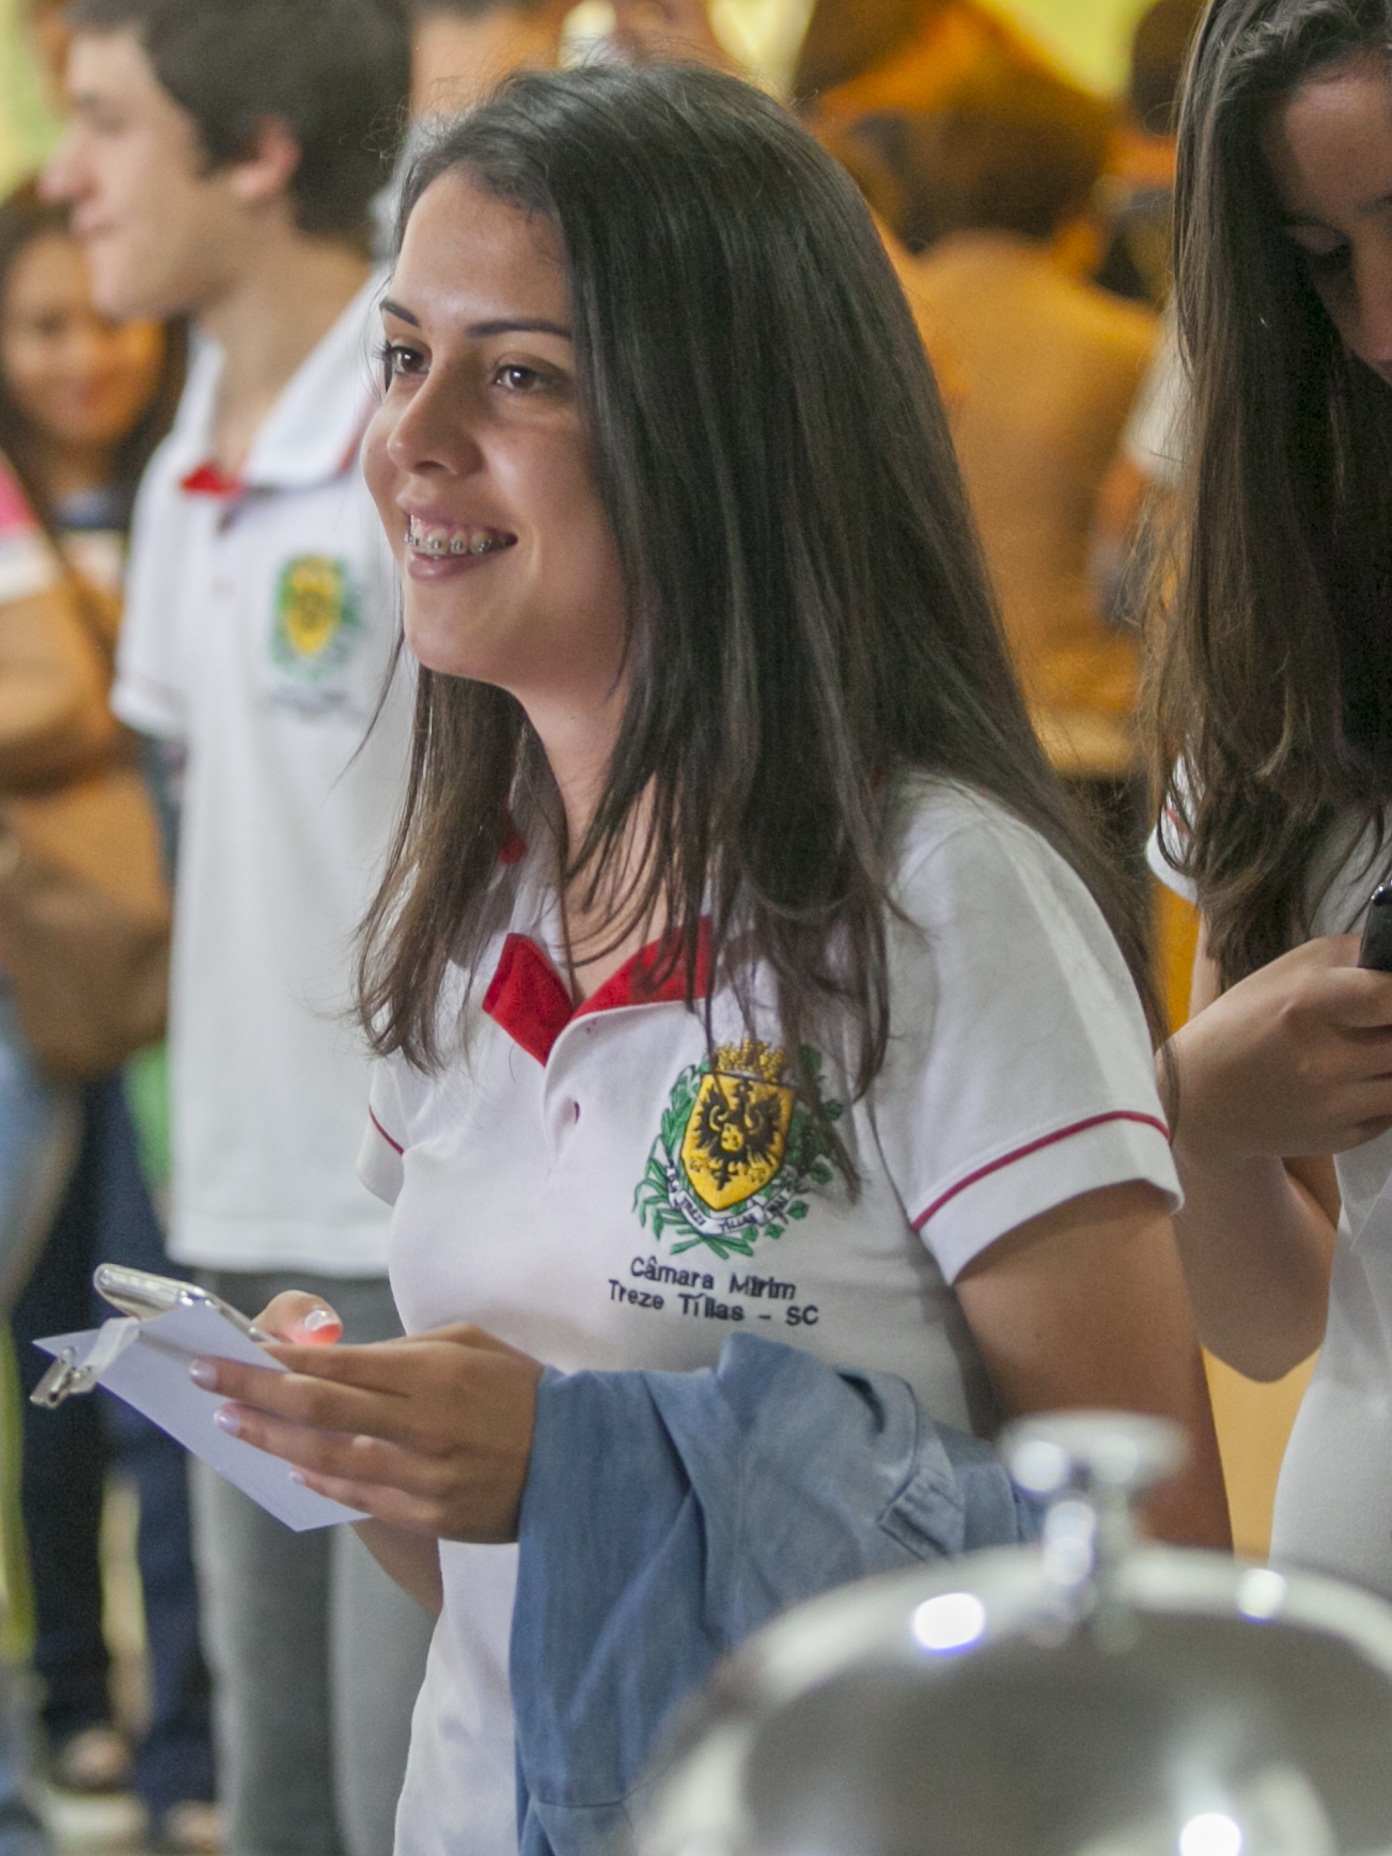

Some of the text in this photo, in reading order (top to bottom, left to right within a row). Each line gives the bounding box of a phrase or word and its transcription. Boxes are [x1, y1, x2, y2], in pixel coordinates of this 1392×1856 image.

[630, 1255, 796, 1300] Câmara Mirim
[608, 1279, 665, 1310] Treze
[677, 1292, 745, 1322] Tílias
[785, 1305, 819, 1327] SC
